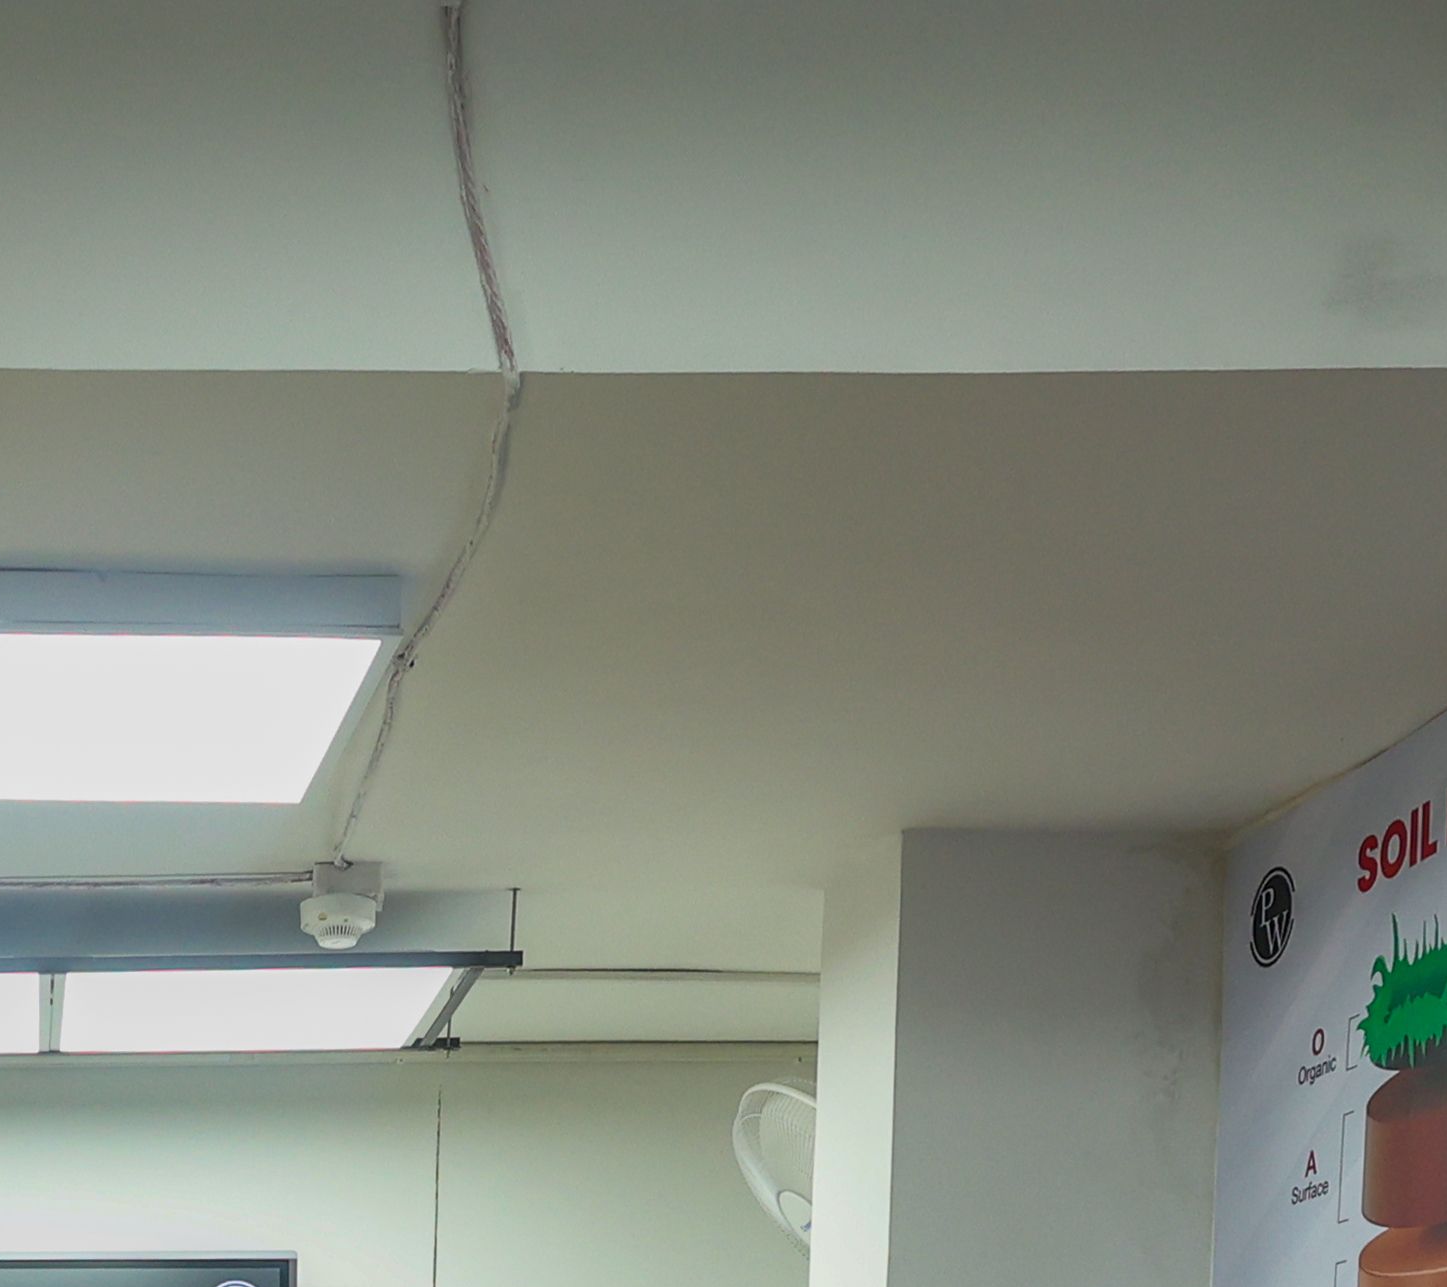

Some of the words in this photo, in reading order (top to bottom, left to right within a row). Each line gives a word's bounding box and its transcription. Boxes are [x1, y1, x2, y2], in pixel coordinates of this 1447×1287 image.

[1358, 800, 1437, 893] SOIL
[1312, 1028, 1324, 1055] O
[1298, 1055, 1336, 1085] Organic
[1305, 1150, 1317, 1178] A
[1291, 1180, 1329, 1205] Surface
